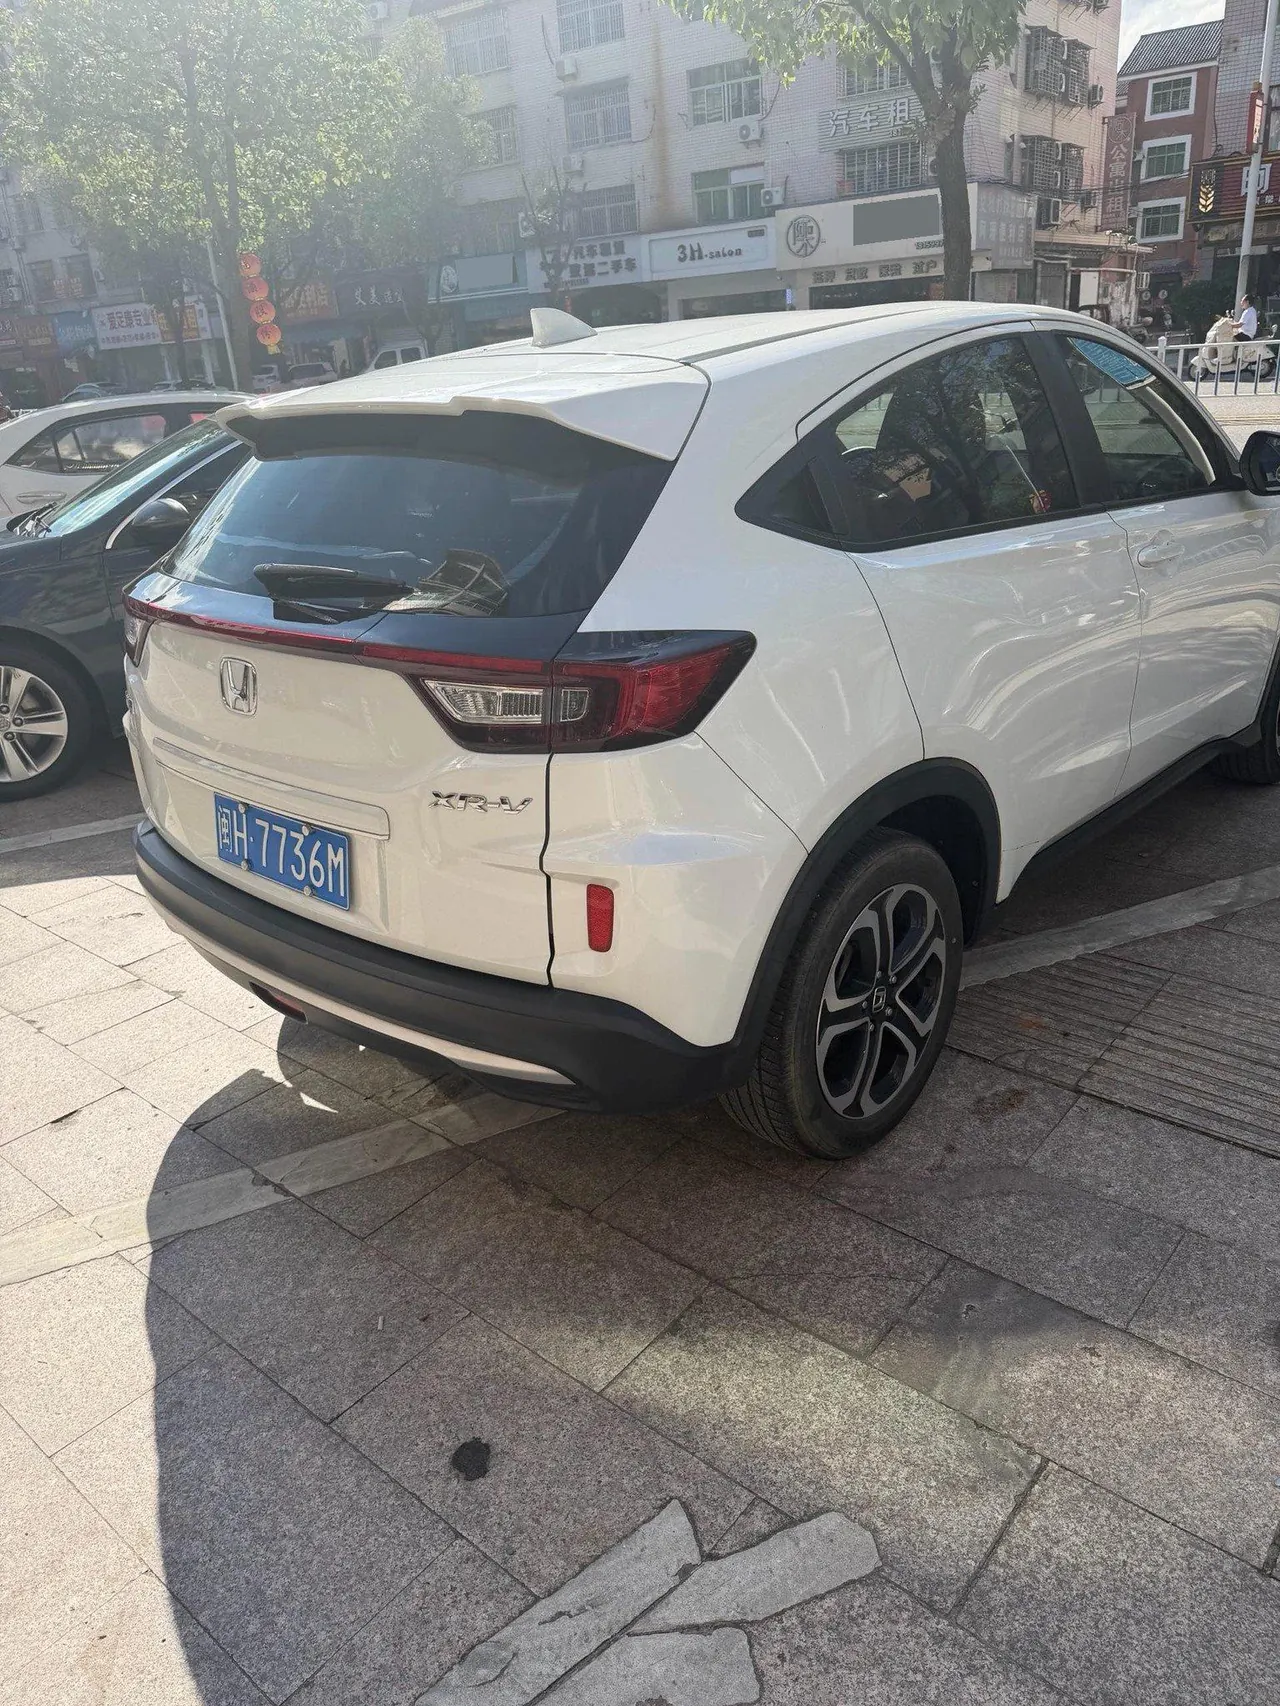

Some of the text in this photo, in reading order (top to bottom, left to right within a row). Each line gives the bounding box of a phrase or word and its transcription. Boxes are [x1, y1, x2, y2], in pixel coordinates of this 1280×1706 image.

[1106, 143, 1129, 213] 公寓出租
[429, 789, 534, 815] XR-V
